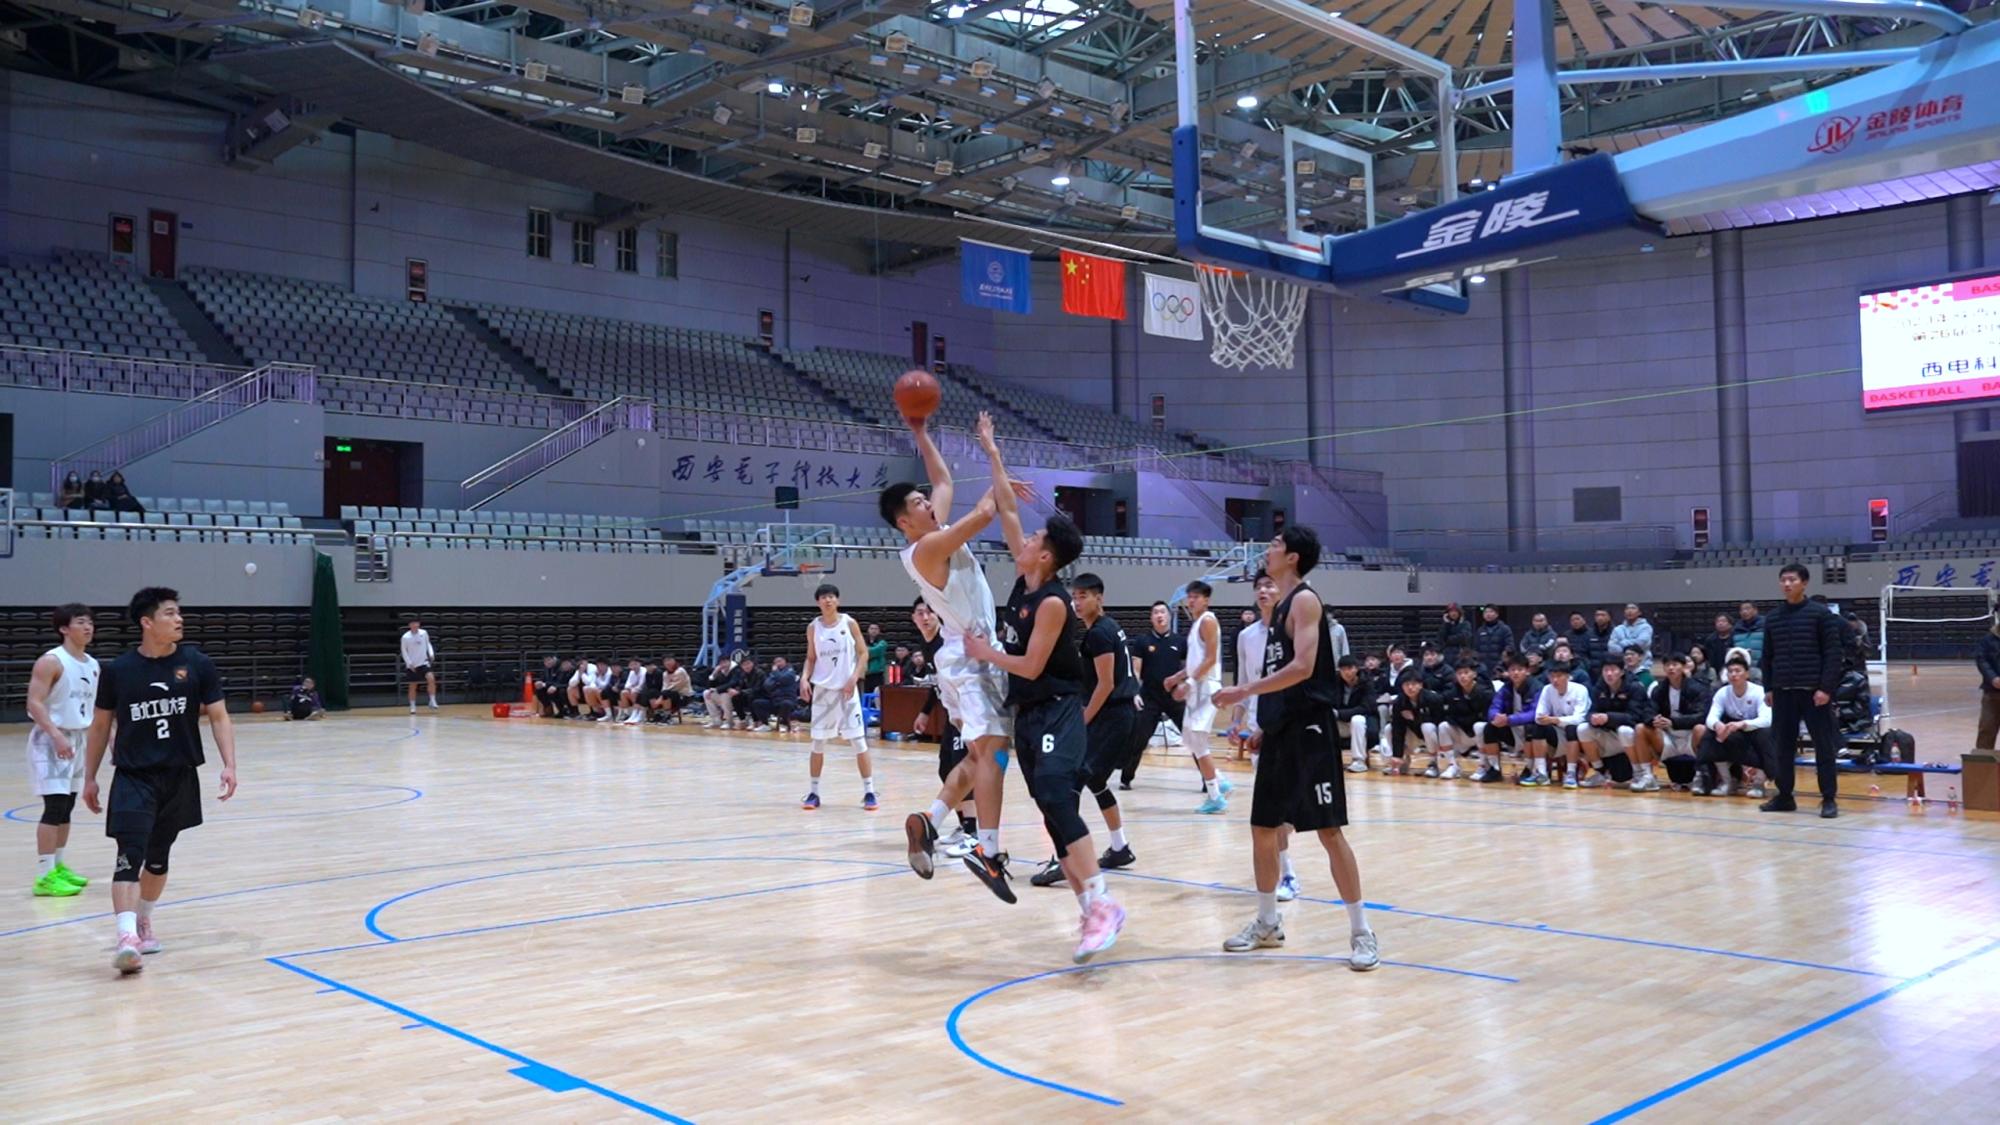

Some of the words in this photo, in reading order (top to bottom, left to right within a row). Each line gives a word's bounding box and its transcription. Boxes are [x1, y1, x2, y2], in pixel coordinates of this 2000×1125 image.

[1864, 94, 1963, 132] 金陵体育
[1415, 190, 1566, 252] 金陵
[1869, 385, 1965, 403] BASKETBALL
[831, 656, 839, 668] 7
[129, 697, 187, 721] 西北工业大学
[156, 718, 170, 739] 2
[1042, 734, 1055, 753] 6
[1314, 782, 1333, 805] 15
